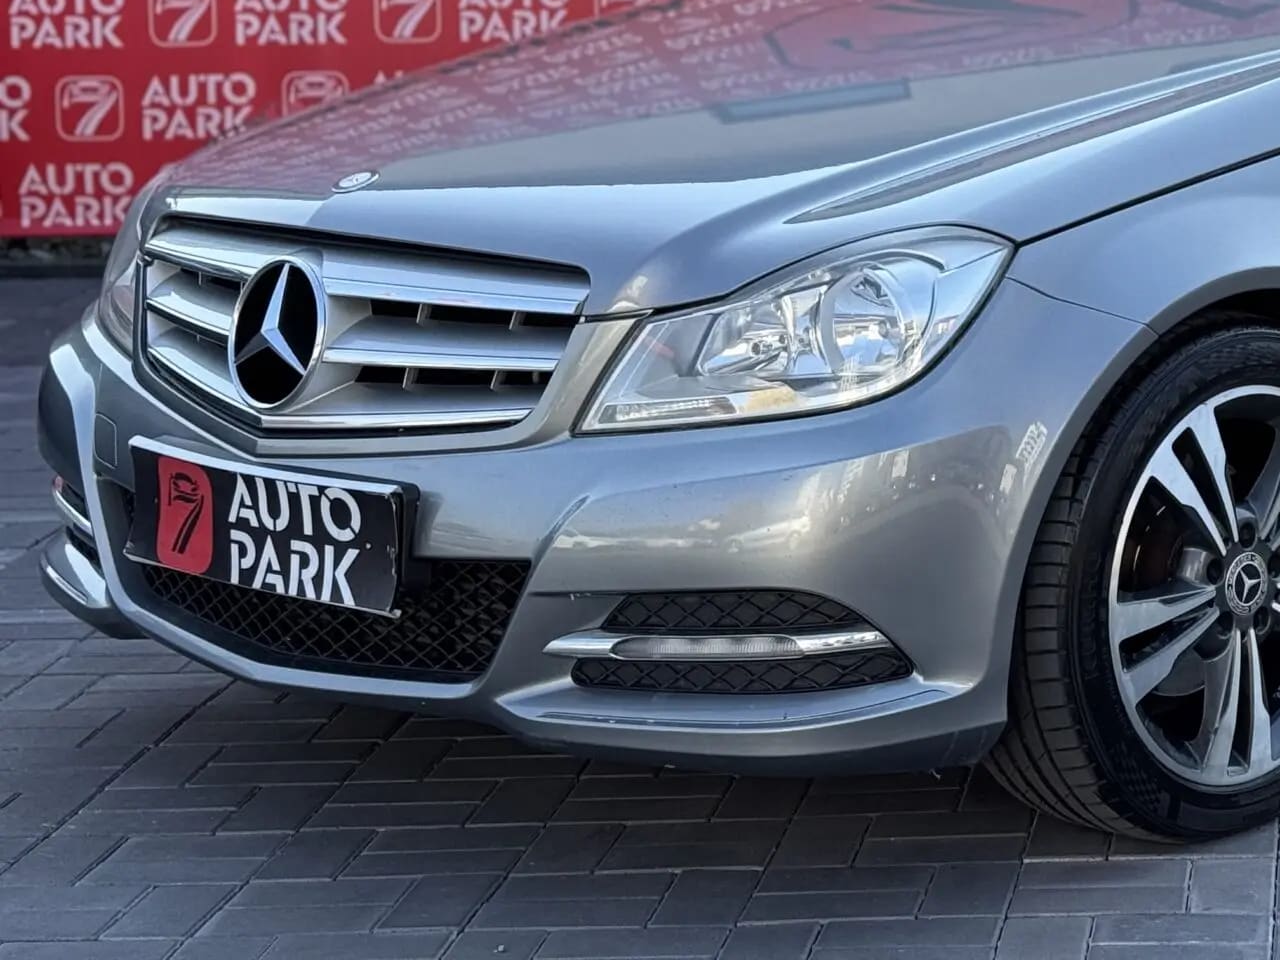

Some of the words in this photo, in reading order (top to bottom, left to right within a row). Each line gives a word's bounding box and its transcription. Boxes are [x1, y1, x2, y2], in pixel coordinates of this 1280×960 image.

[10, 14, 123, 48] PARK
[235, 11, 346, 46] PARK
[460, 8, 567, 45] PARK
[142, 72, 256, 105] AUTO
[142, 106, 252, 141] PARK
[19, 162, 133, 195] AUTO
[19, 195, 132, 229] PARK
[227, 472, 362, 543] AUTO
[228, 528, 361, 607] PARK
